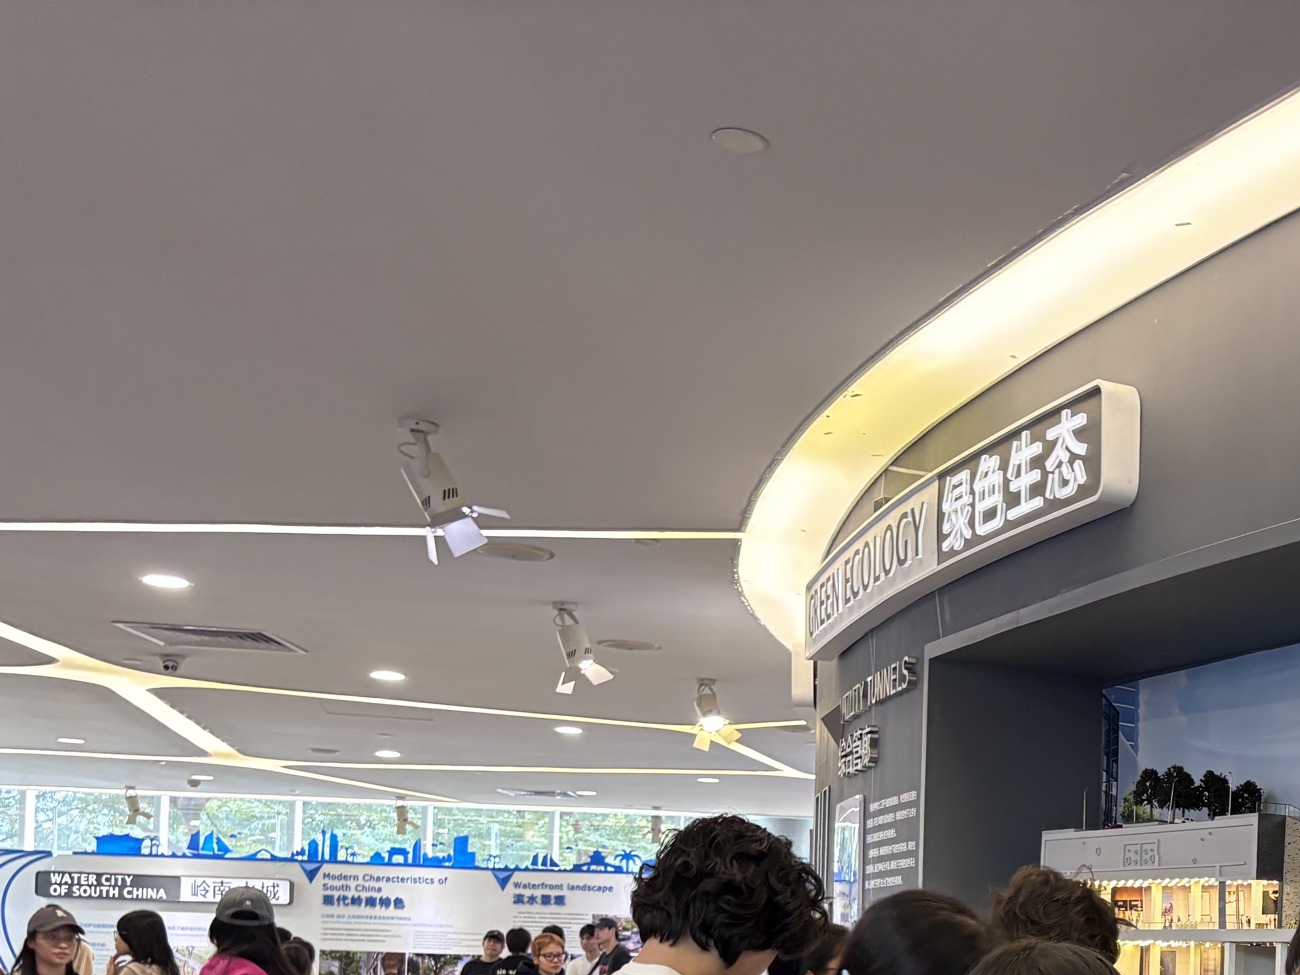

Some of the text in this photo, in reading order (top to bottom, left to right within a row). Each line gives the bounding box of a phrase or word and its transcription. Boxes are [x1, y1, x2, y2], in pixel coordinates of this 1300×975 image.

[942, 409, 1087, 552] 绿色生态
[808, 501, 928, 638] GREEN ECOLOGY
[866, 656, 909, 706] TUNNELS
[50, 873, 133, 886] WATER CITY
[323, 872, 448, 885] Modern Characteristics of
[50, 885, 167, 900] OF SOUTH CHINA
[191, 880, 280, 901] 岭南城
[322, 883, 382, 893] South China
[513, 881, 614, 893] Waterfront landscape
[322, 894, 406, 910] 现代岭南特色
